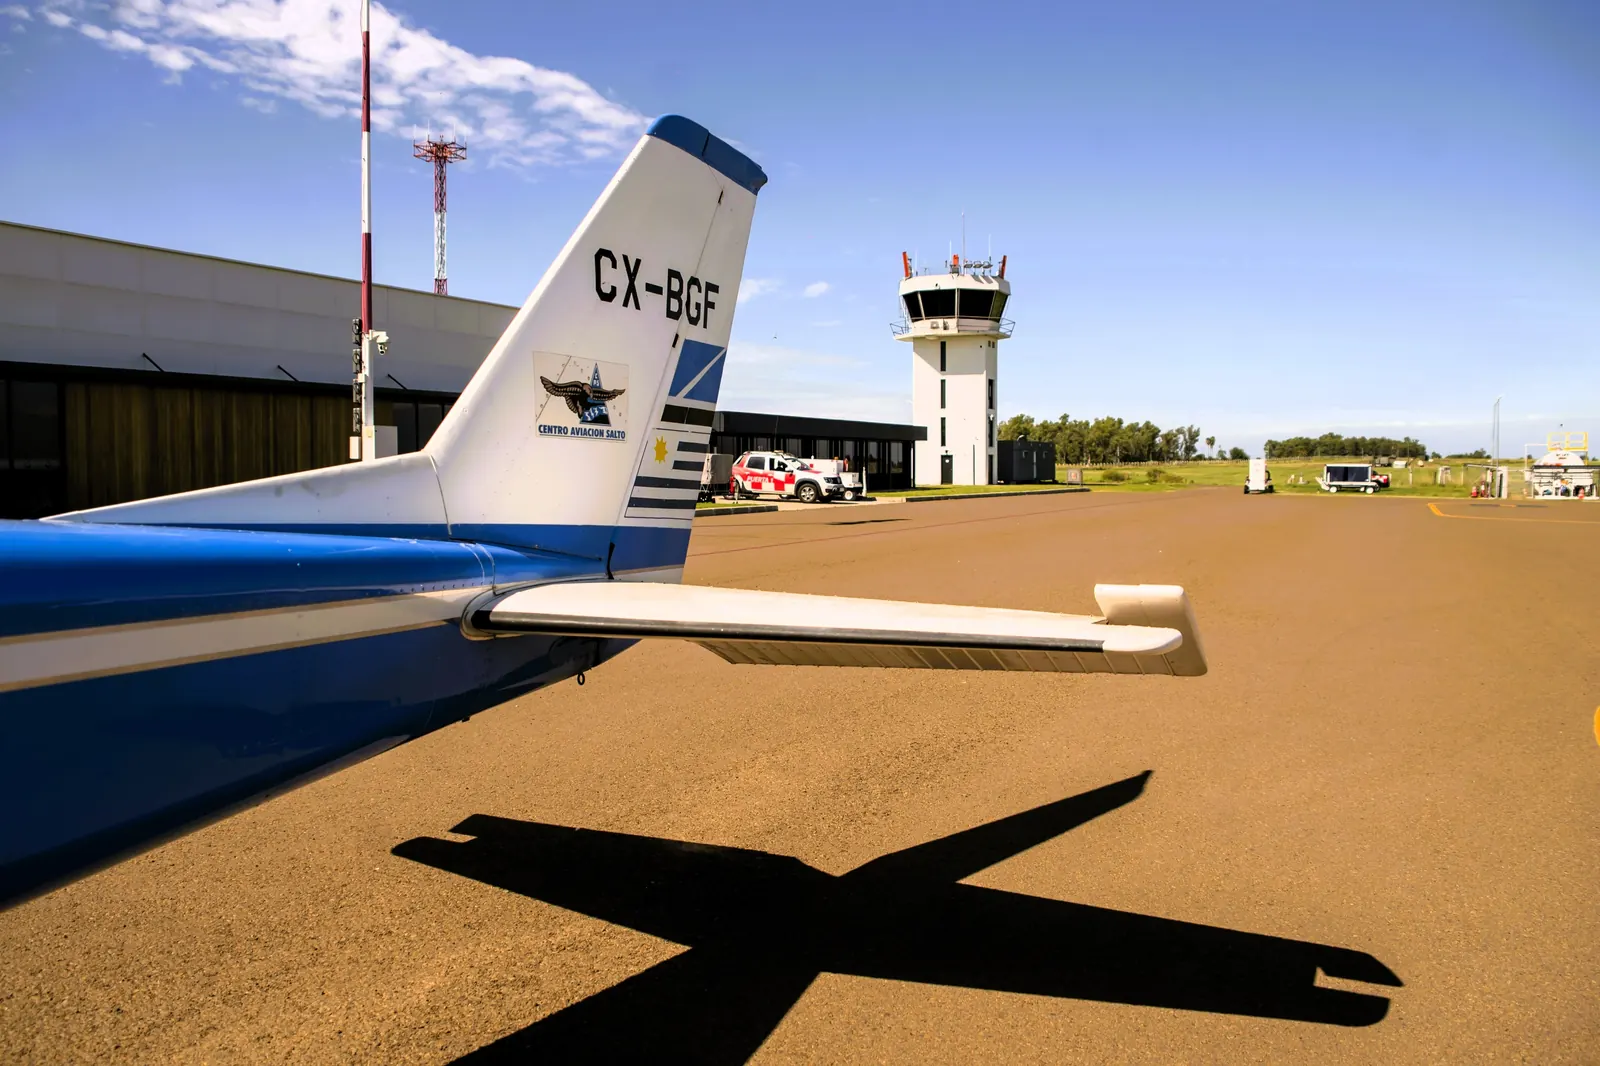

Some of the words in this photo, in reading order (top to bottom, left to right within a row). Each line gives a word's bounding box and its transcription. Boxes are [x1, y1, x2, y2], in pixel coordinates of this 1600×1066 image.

[594, 248, 719, 329] CX-BGF
[538, 424, 568, 435] CENTRO
[570, 426, 604, 438] AVIACION
[606, 429, 626, 439] SALTO
